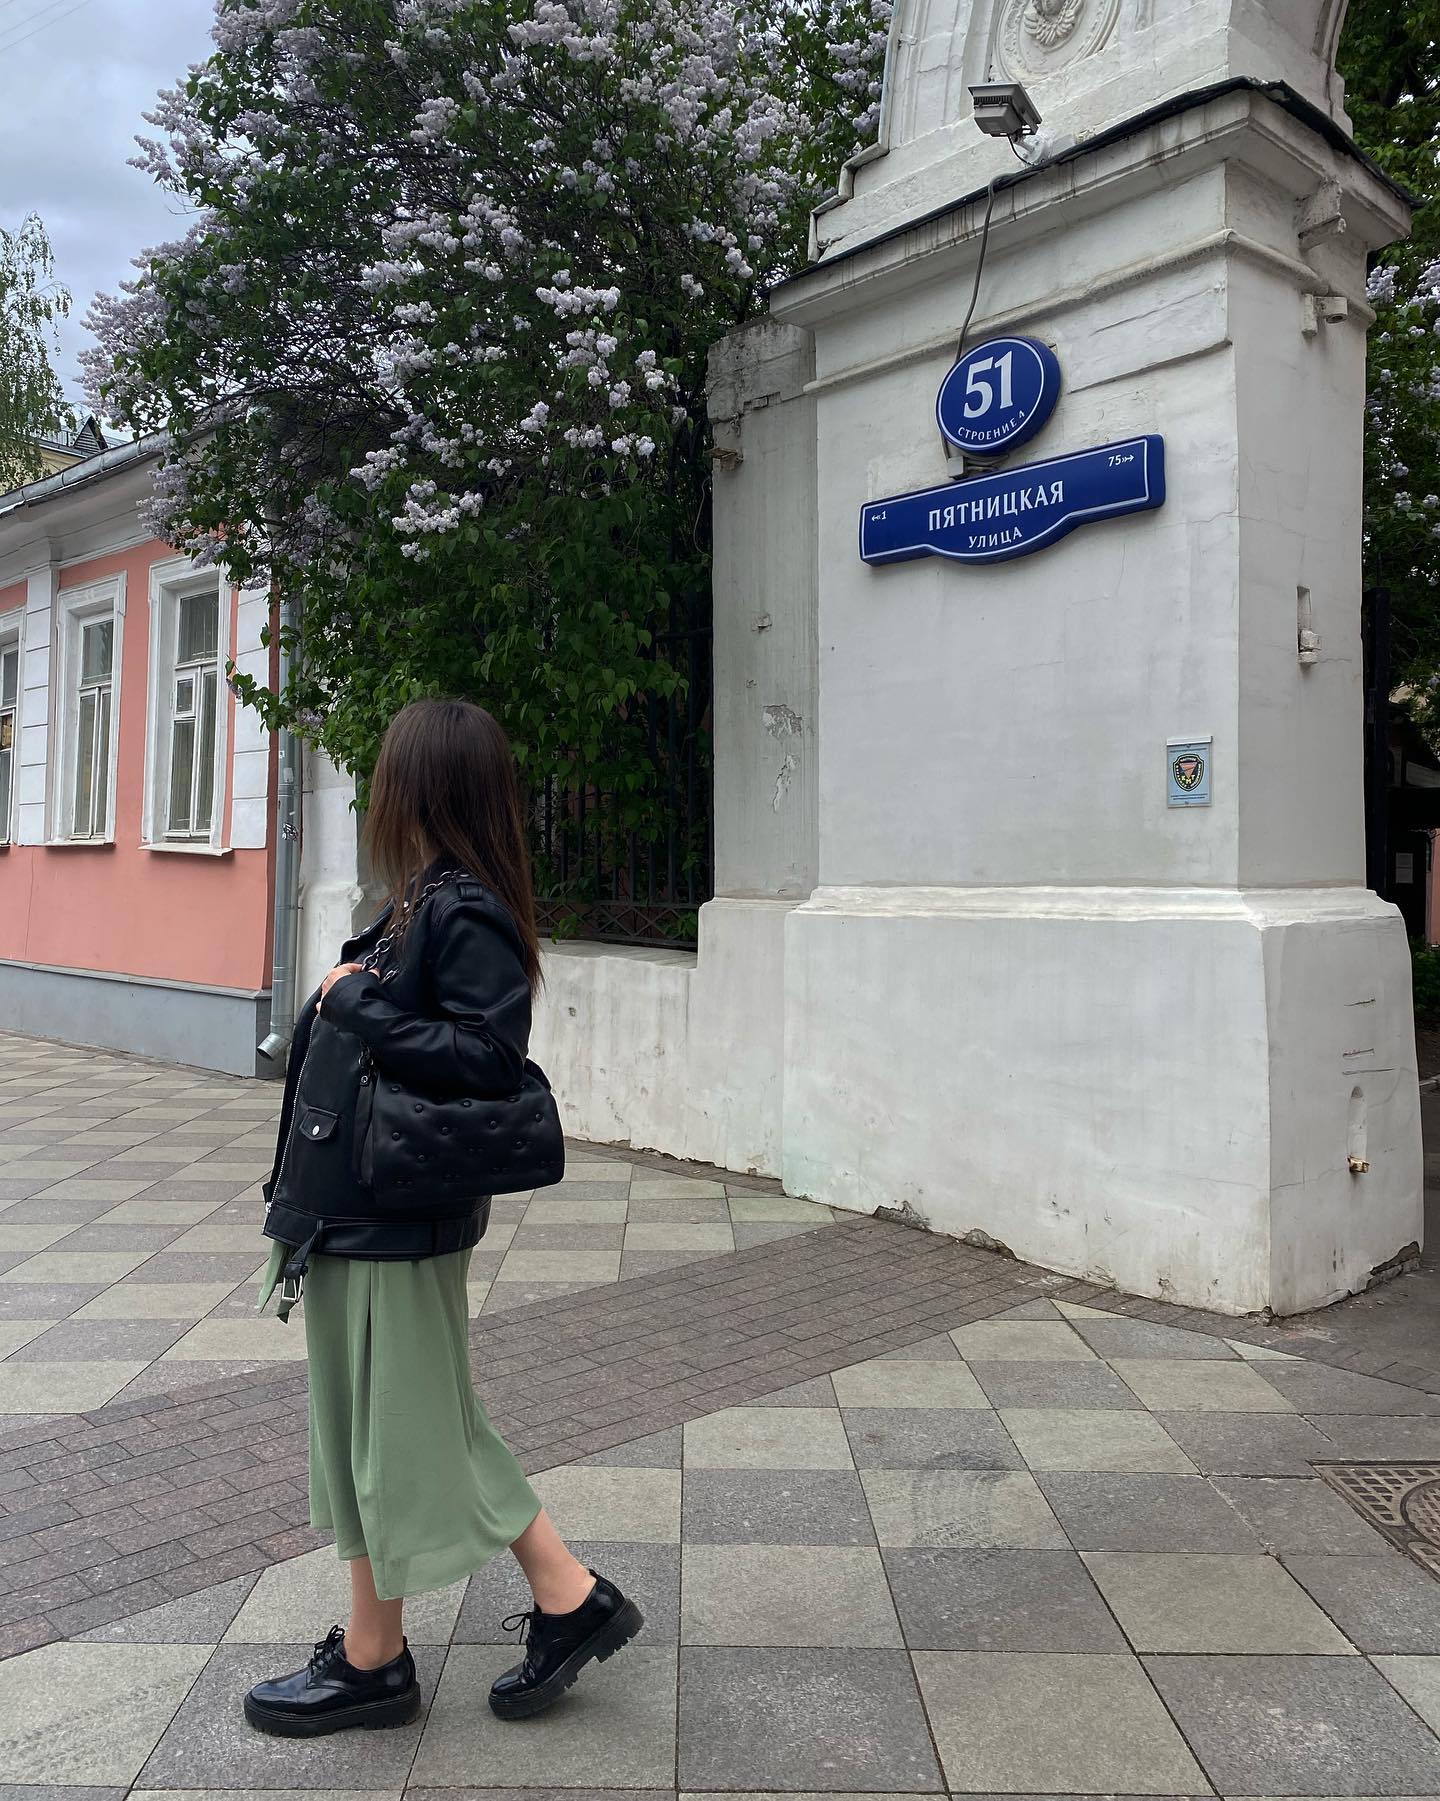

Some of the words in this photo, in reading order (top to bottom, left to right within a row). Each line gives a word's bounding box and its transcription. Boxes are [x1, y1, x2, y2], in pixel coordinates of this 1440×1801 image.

[963, 350, 1014, 418] 51
[957, 417, 1017, 441] СТРОЕНИЕ
[1108, 454, 1121, 467] 75
[880, 510, 887, 520] 1
[928, 480, 1064, 532] ПЯТНИЦКАЯ
[968, 526, 1023, 549] УЛИЦА
